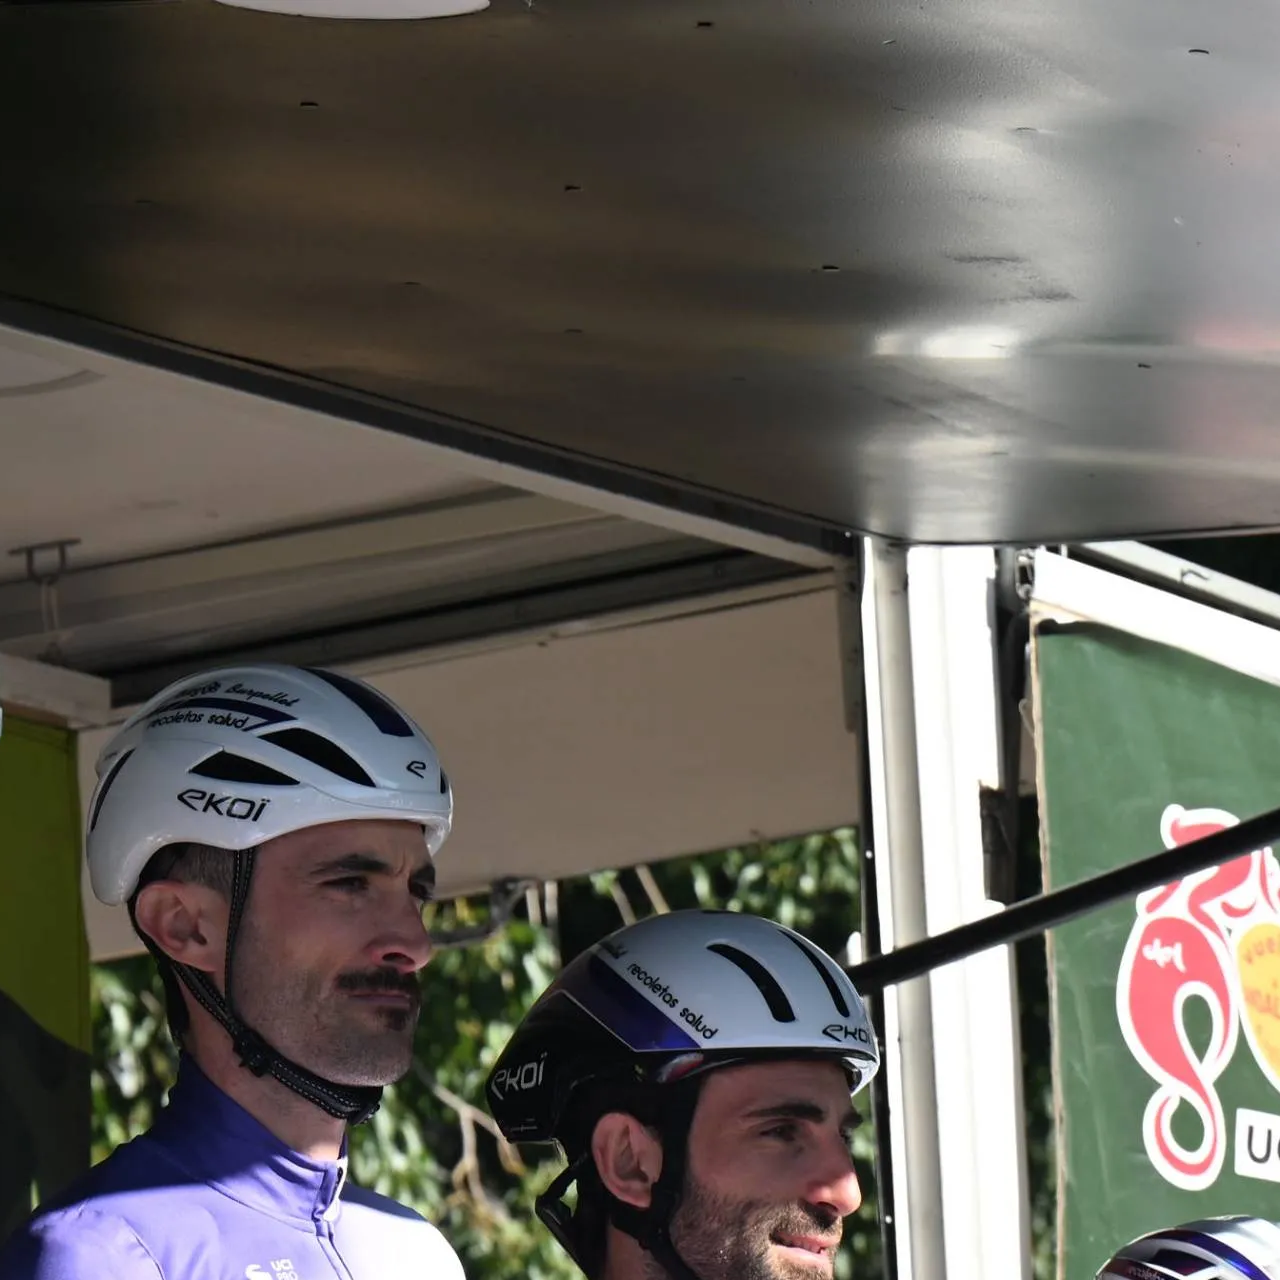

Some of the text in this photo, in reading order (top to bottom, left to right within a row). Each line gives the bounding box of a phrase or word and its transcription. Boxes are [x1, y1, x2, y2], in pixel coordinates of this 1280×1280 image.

[207, 711, 250, 730] salud
[625, 960, 720, 1041] recoletas salud
